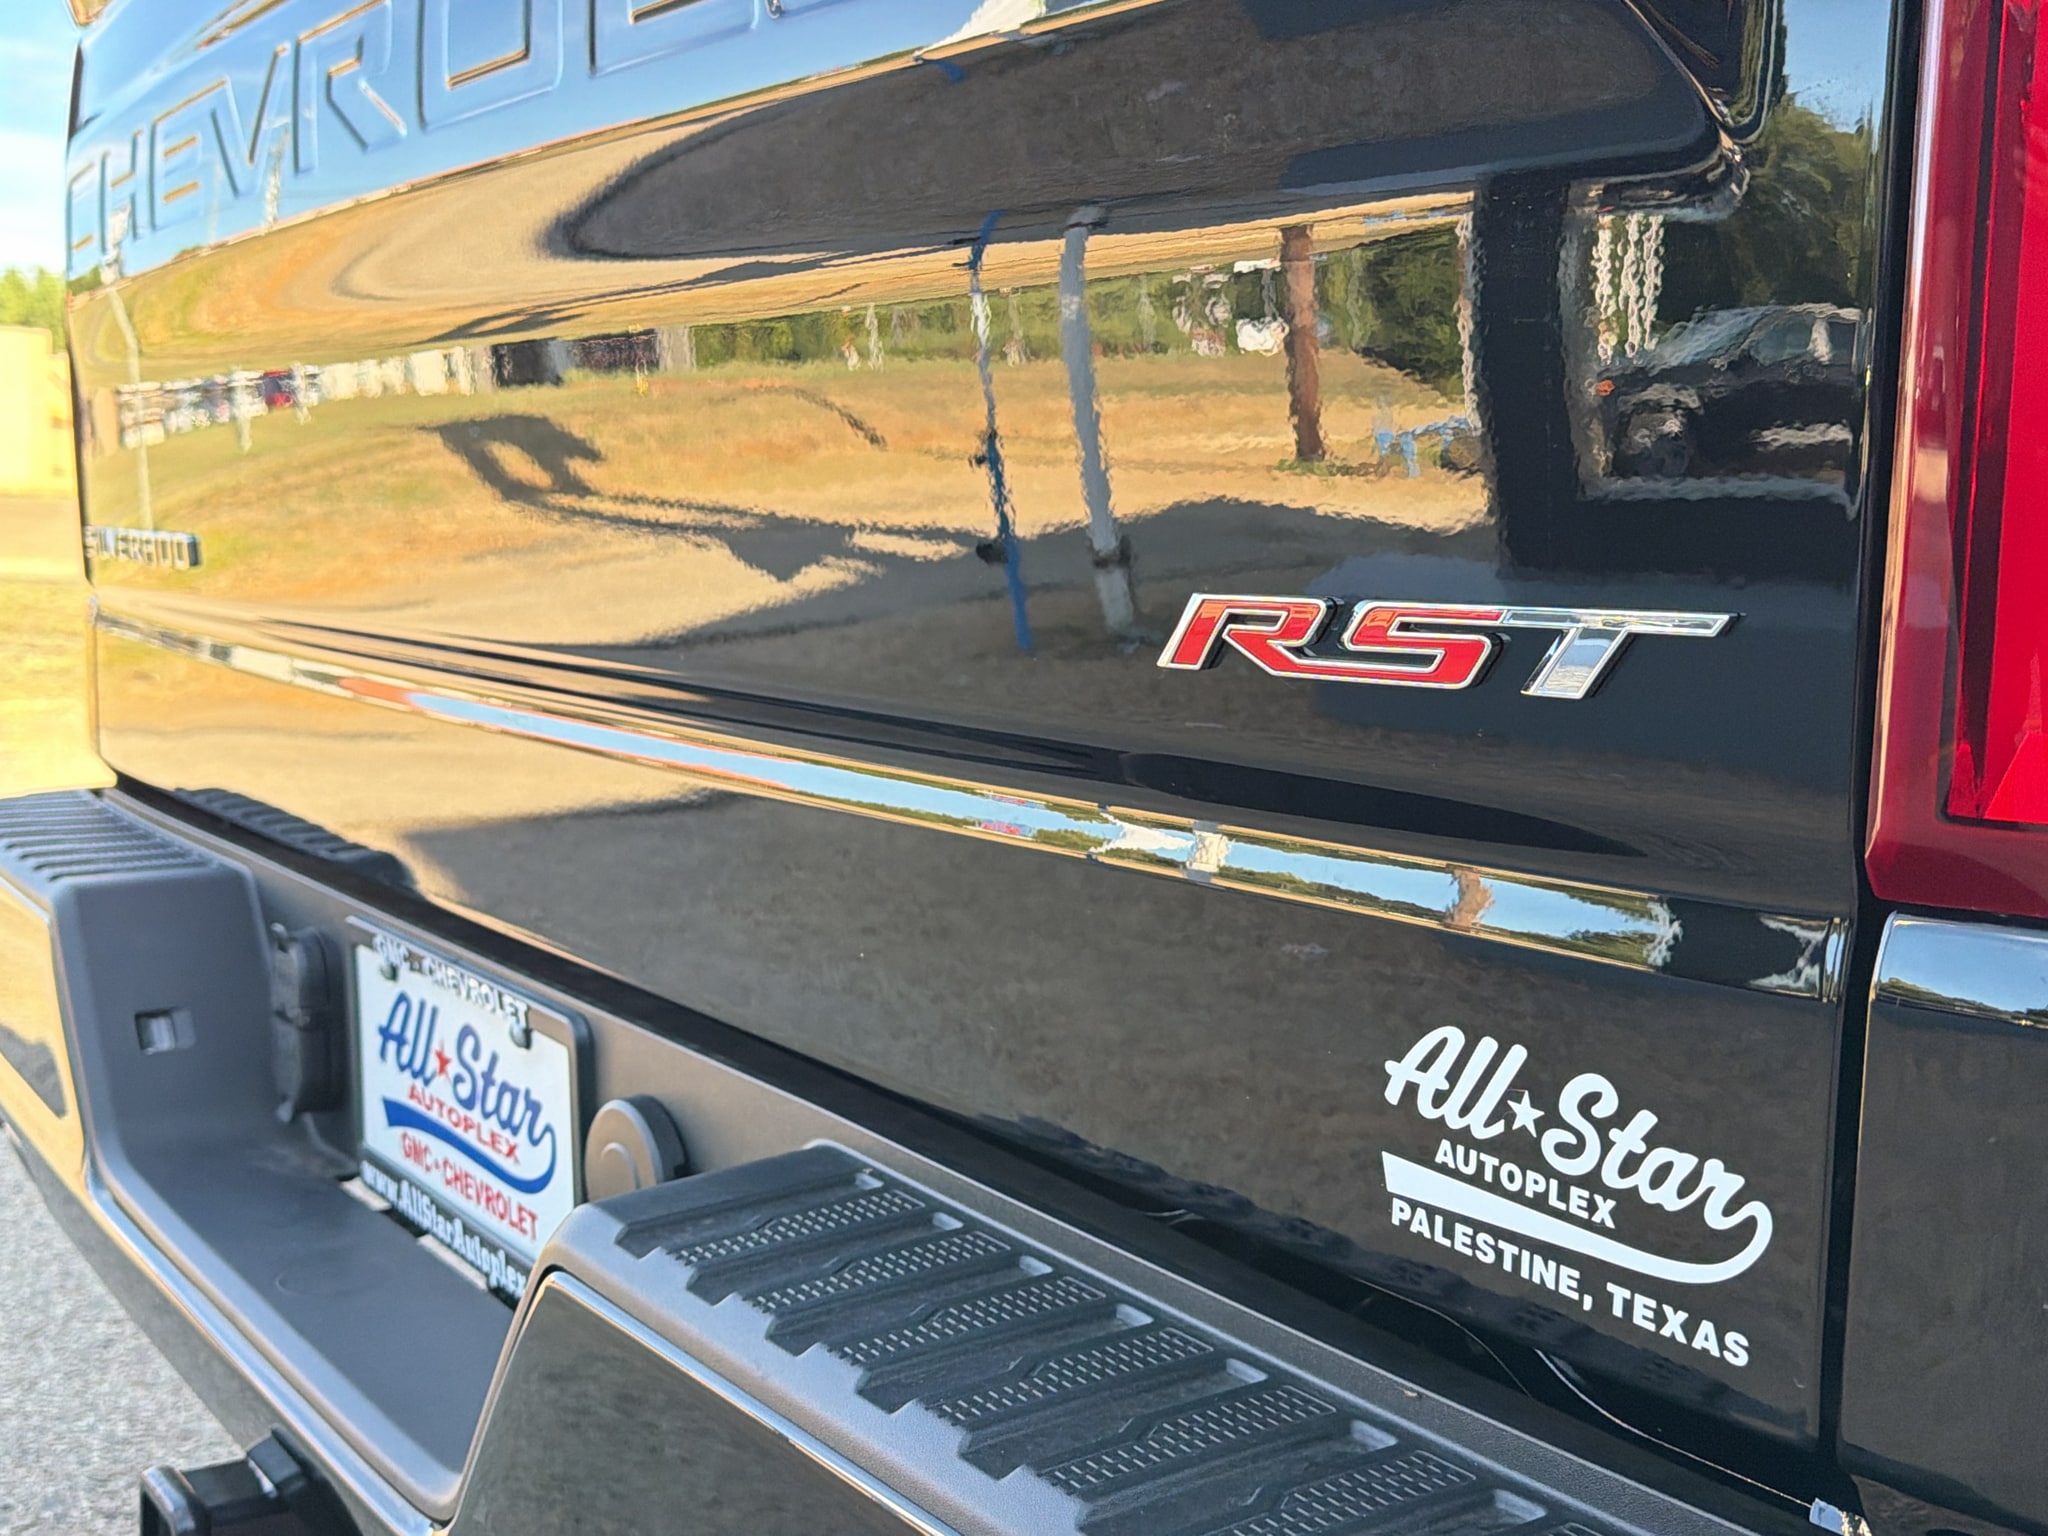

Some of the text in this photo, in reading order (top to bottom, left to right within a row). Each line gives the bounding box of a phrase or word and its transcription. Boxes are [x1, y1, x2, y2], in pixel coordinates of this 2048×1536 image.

[1156, 592, 1741, 700] RST
[421, 956, 528, 1027] CHEVROLET
[378, 990, 556, 1149] All Star
[408, 1082, 521, 1166] AUTOPLEX
[1384, 1025, 1773, 1232] All Star
[1434, 1138, 1617, 1230] AUTOPLEX
[1391, 1197, 1751, 1368] PALESTINE, TEXAS
